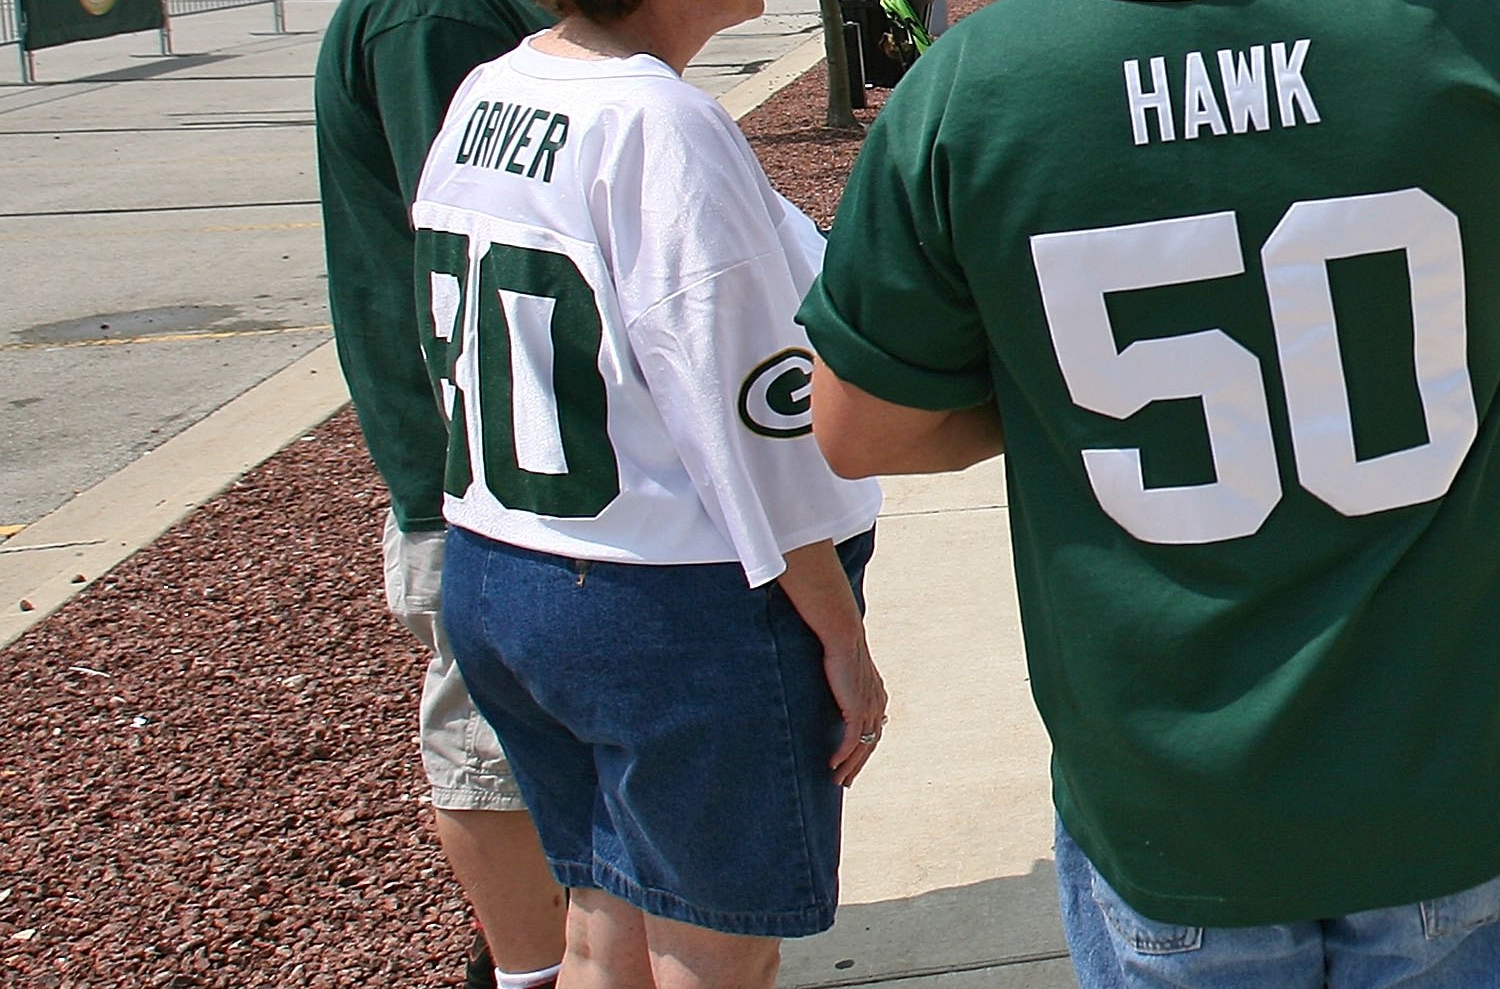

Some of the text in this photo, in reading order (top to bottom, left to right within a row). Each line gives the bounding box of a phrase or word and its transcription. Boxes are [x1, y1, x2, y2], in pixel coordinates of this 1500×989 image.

[455, 100, 570, 184] DRIVER
[1123, 39, 1321, 145] HAWK
[1030, 188, 1479, 545] 50
